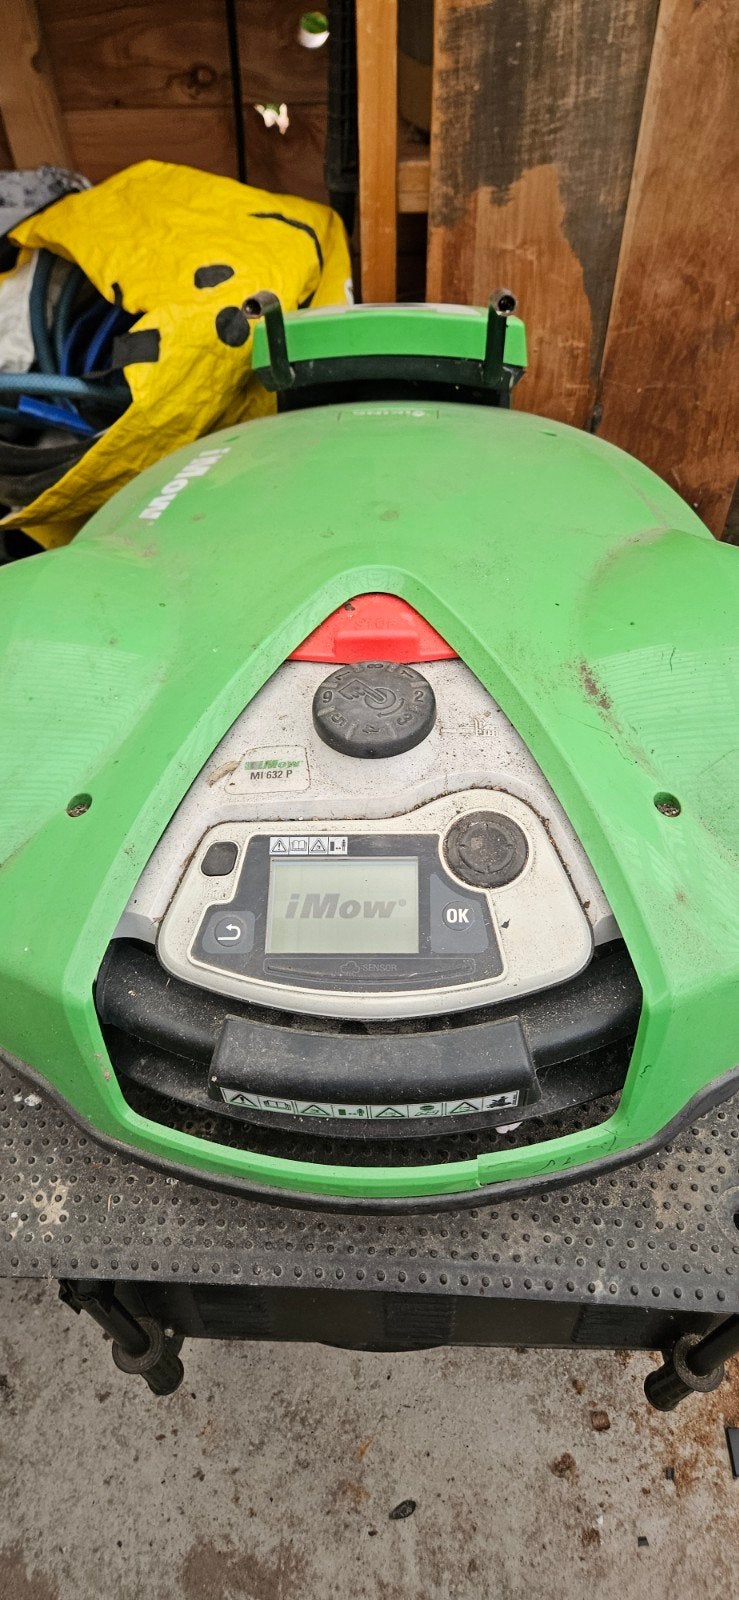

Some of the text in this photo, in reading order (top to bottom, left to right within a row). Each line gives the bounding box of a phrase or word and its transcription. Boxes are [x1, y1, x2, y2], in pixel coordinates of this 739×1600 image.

[414, 690, 424, 703] 2
[266, 770, 283, 779] 632
[286, 769, 293, 778] P
[446, 908, 469, 923] OK
[361, 963, 398, 972] SENSOR
